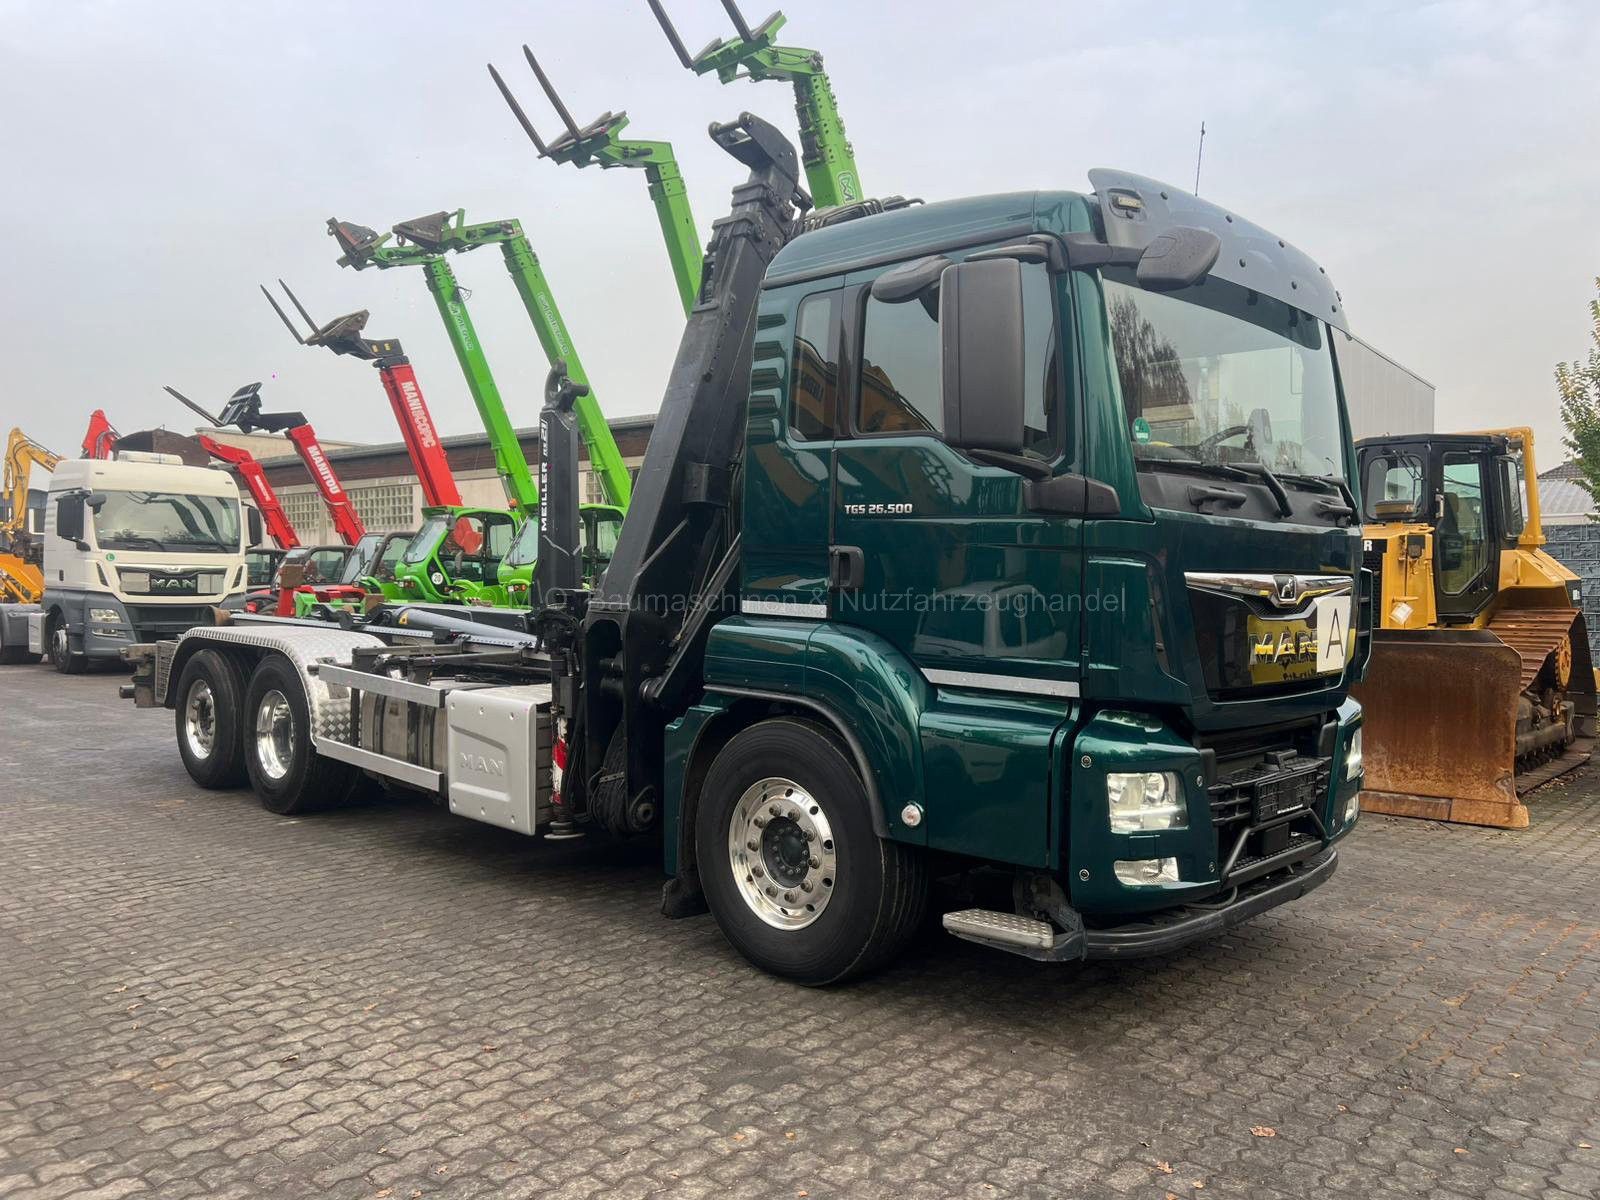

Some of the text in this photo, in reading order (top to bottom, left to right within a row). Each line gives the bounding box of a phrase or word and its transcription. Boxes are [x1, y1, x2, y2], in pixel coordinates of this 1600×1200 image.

[306, 445, 342, 495] MANITOU
[844, 503, 913, 514] TGS 26.500
[150, 577, 197, 589] MAN
[1325, 608, 1345, 659] A
[459, 752, 505, 777] MAN
